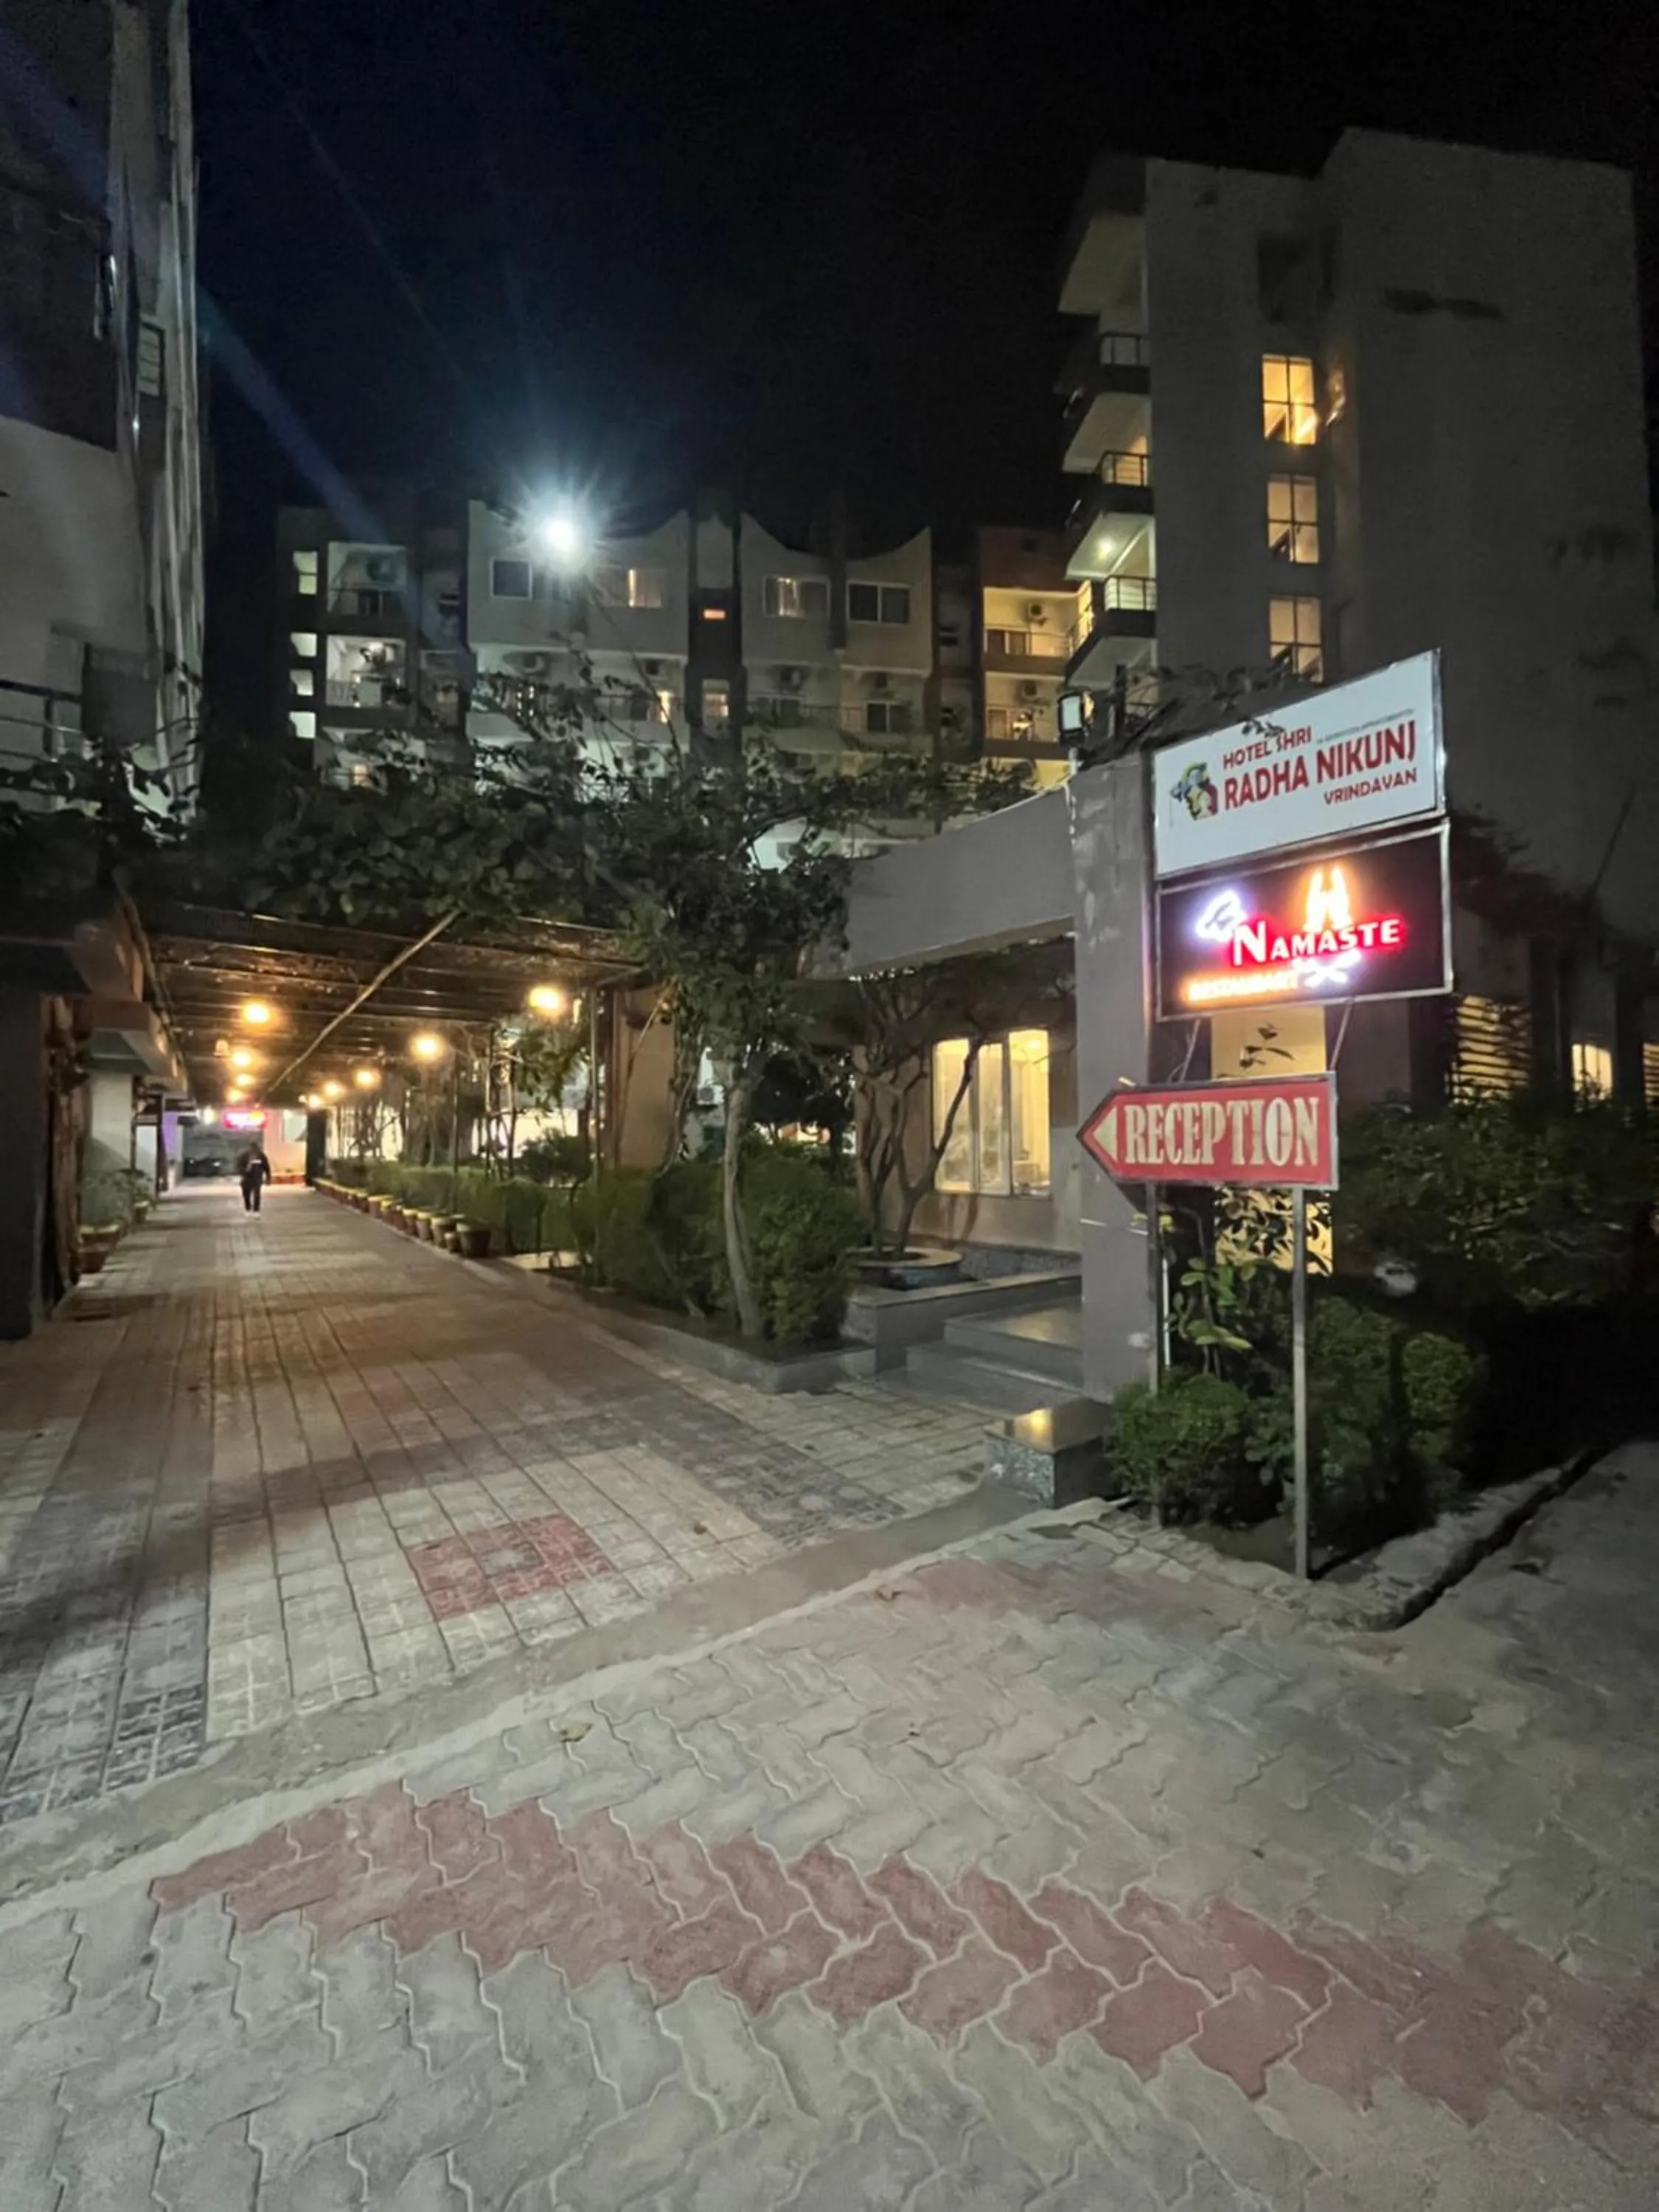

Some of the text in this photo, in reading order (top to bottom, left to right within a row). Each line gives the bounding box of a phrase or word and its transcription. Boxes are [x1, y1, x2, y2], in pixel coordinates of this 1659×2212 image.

[1223, 740, 1272, 769] HOTEL
[1276, 725, 1312, 752] SHRI
[1224, 754, 1310, 810] RADHA
[1316, 719, 1415, 784] NIKUNJ
[1324, 767, 1417, 805] VRINDAVAN
[1124, 1096, 1319, 1166] RECEPTION
